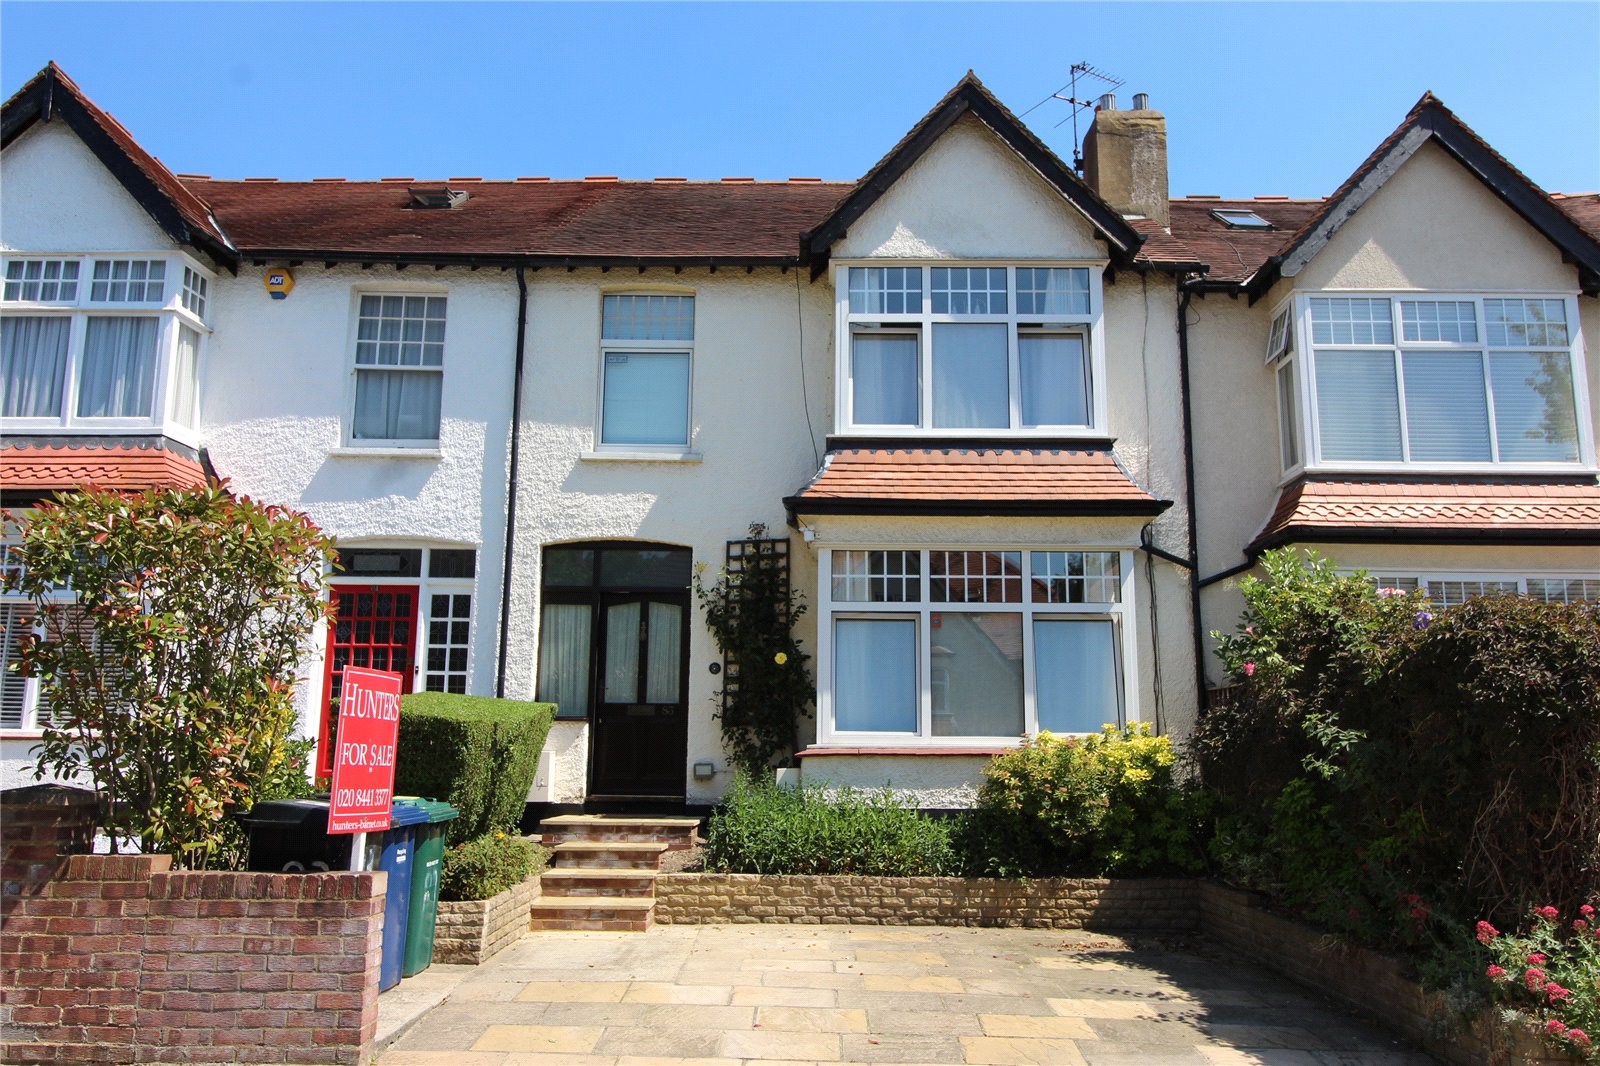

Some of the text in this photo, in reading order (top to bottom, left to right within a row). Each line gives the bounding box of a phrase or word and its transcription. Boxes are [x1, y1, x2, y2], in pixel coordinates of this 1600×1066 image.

[270, 276, 284, 284] ADT
[342, 682, 400, 722] HUNTERS
[341, 742, 393, 767] FOR SALE
[337, 788, 389, 807] 020 8441 3377
